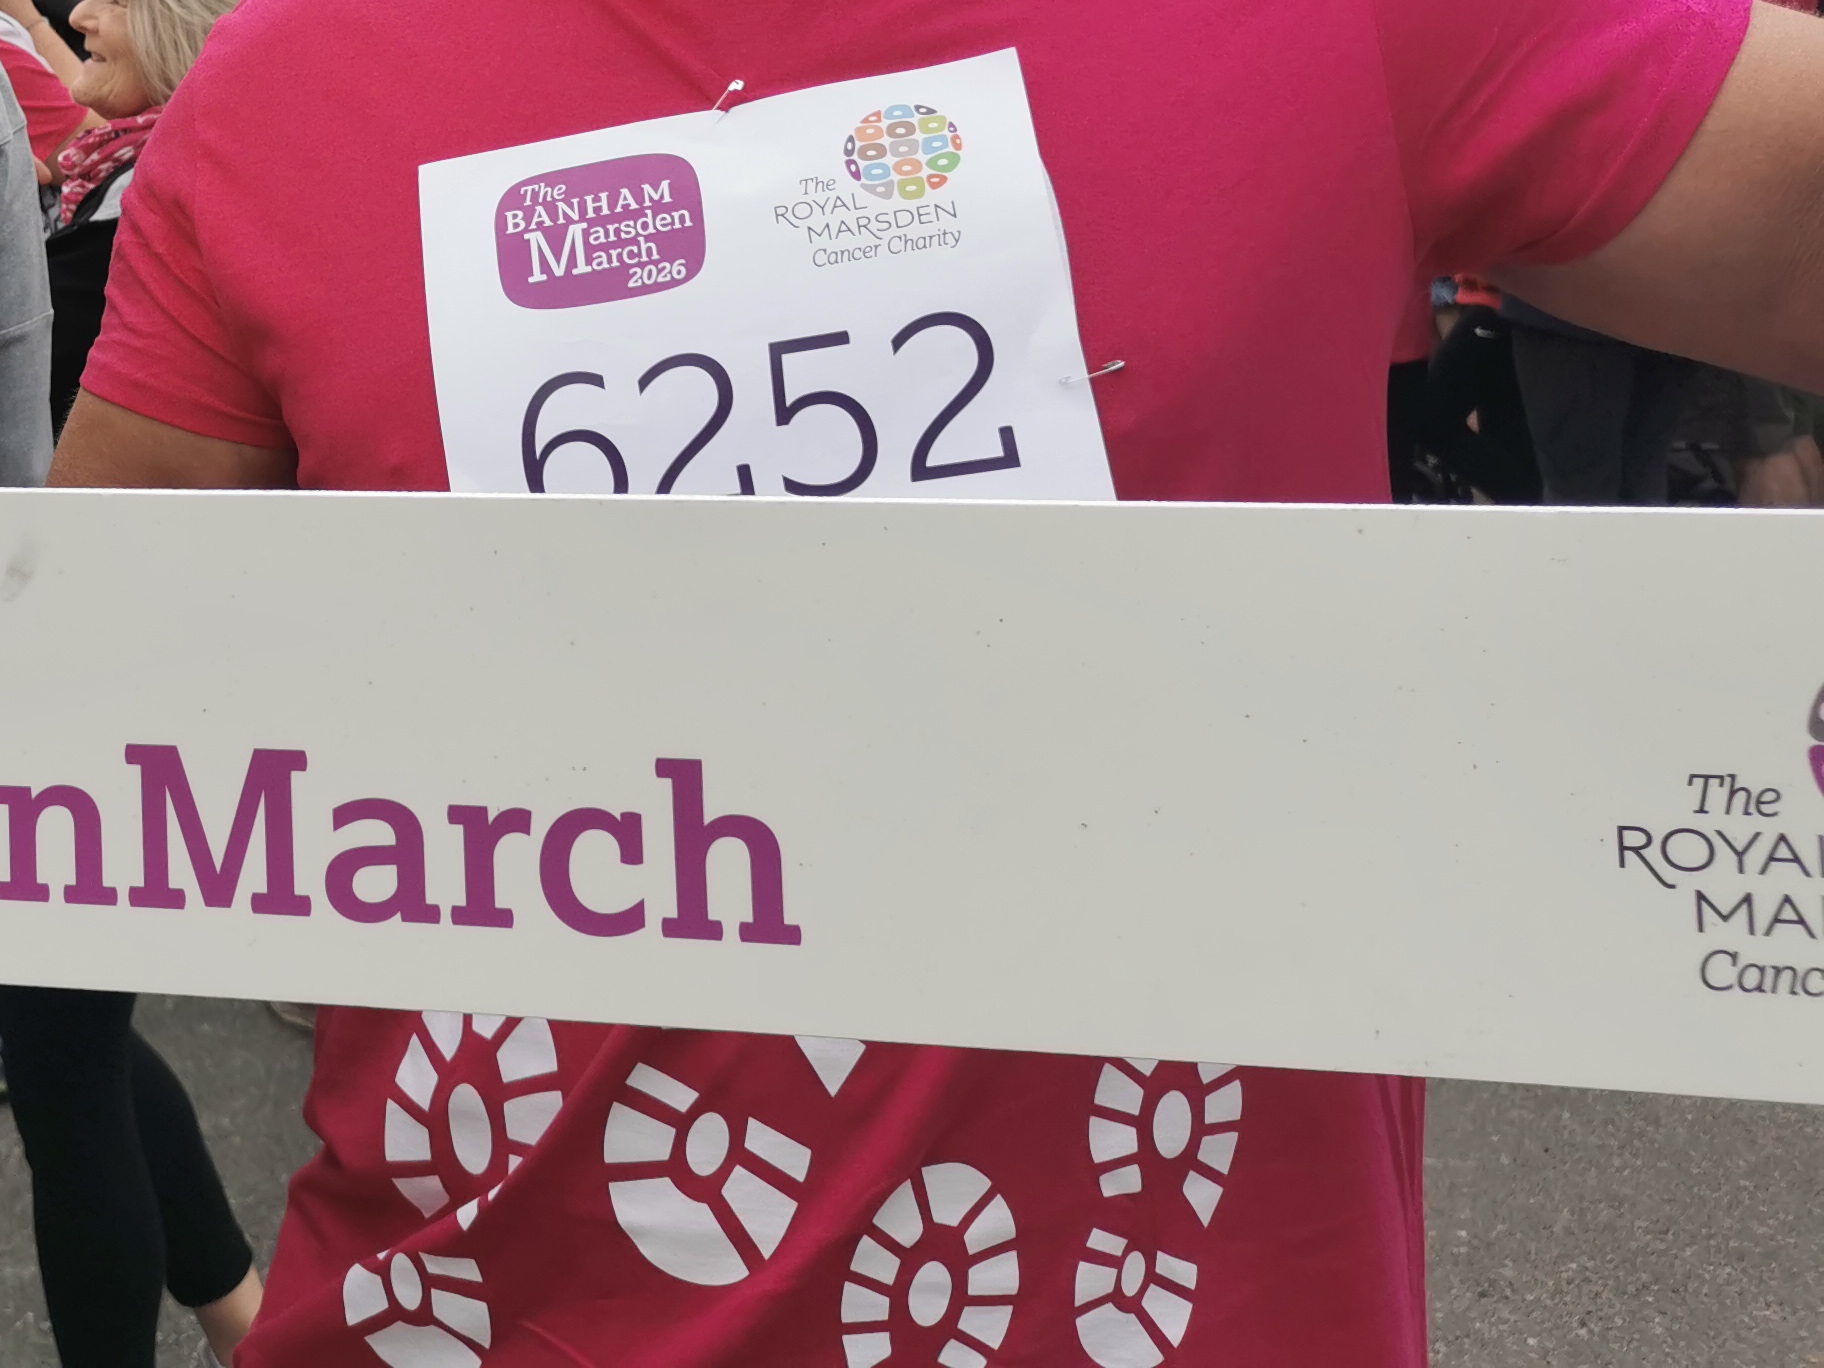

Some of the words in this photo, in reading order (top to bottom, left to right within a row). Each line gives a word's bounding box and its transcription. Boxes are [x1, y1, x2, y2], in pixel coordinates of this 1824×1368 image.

[504, 180, 673, 234] BANHAM
[520, 183, 566, 207] The
[799, 176, 836, 196] The
[774, 193, 868, 228] ROYAL
[807, 200, 957, 244] MARSDEN
[813, 243, 881, 267] Cancer
[887, 229, 962, 255] Charity
[627, 259, 687, 288] 2026
[521, 312, 1021, 496] 6252
[1687, 773, 1782, 817] The
[1617, 825, 1824, 889] ROYA
[1694, 889, 1824, 940] MA
